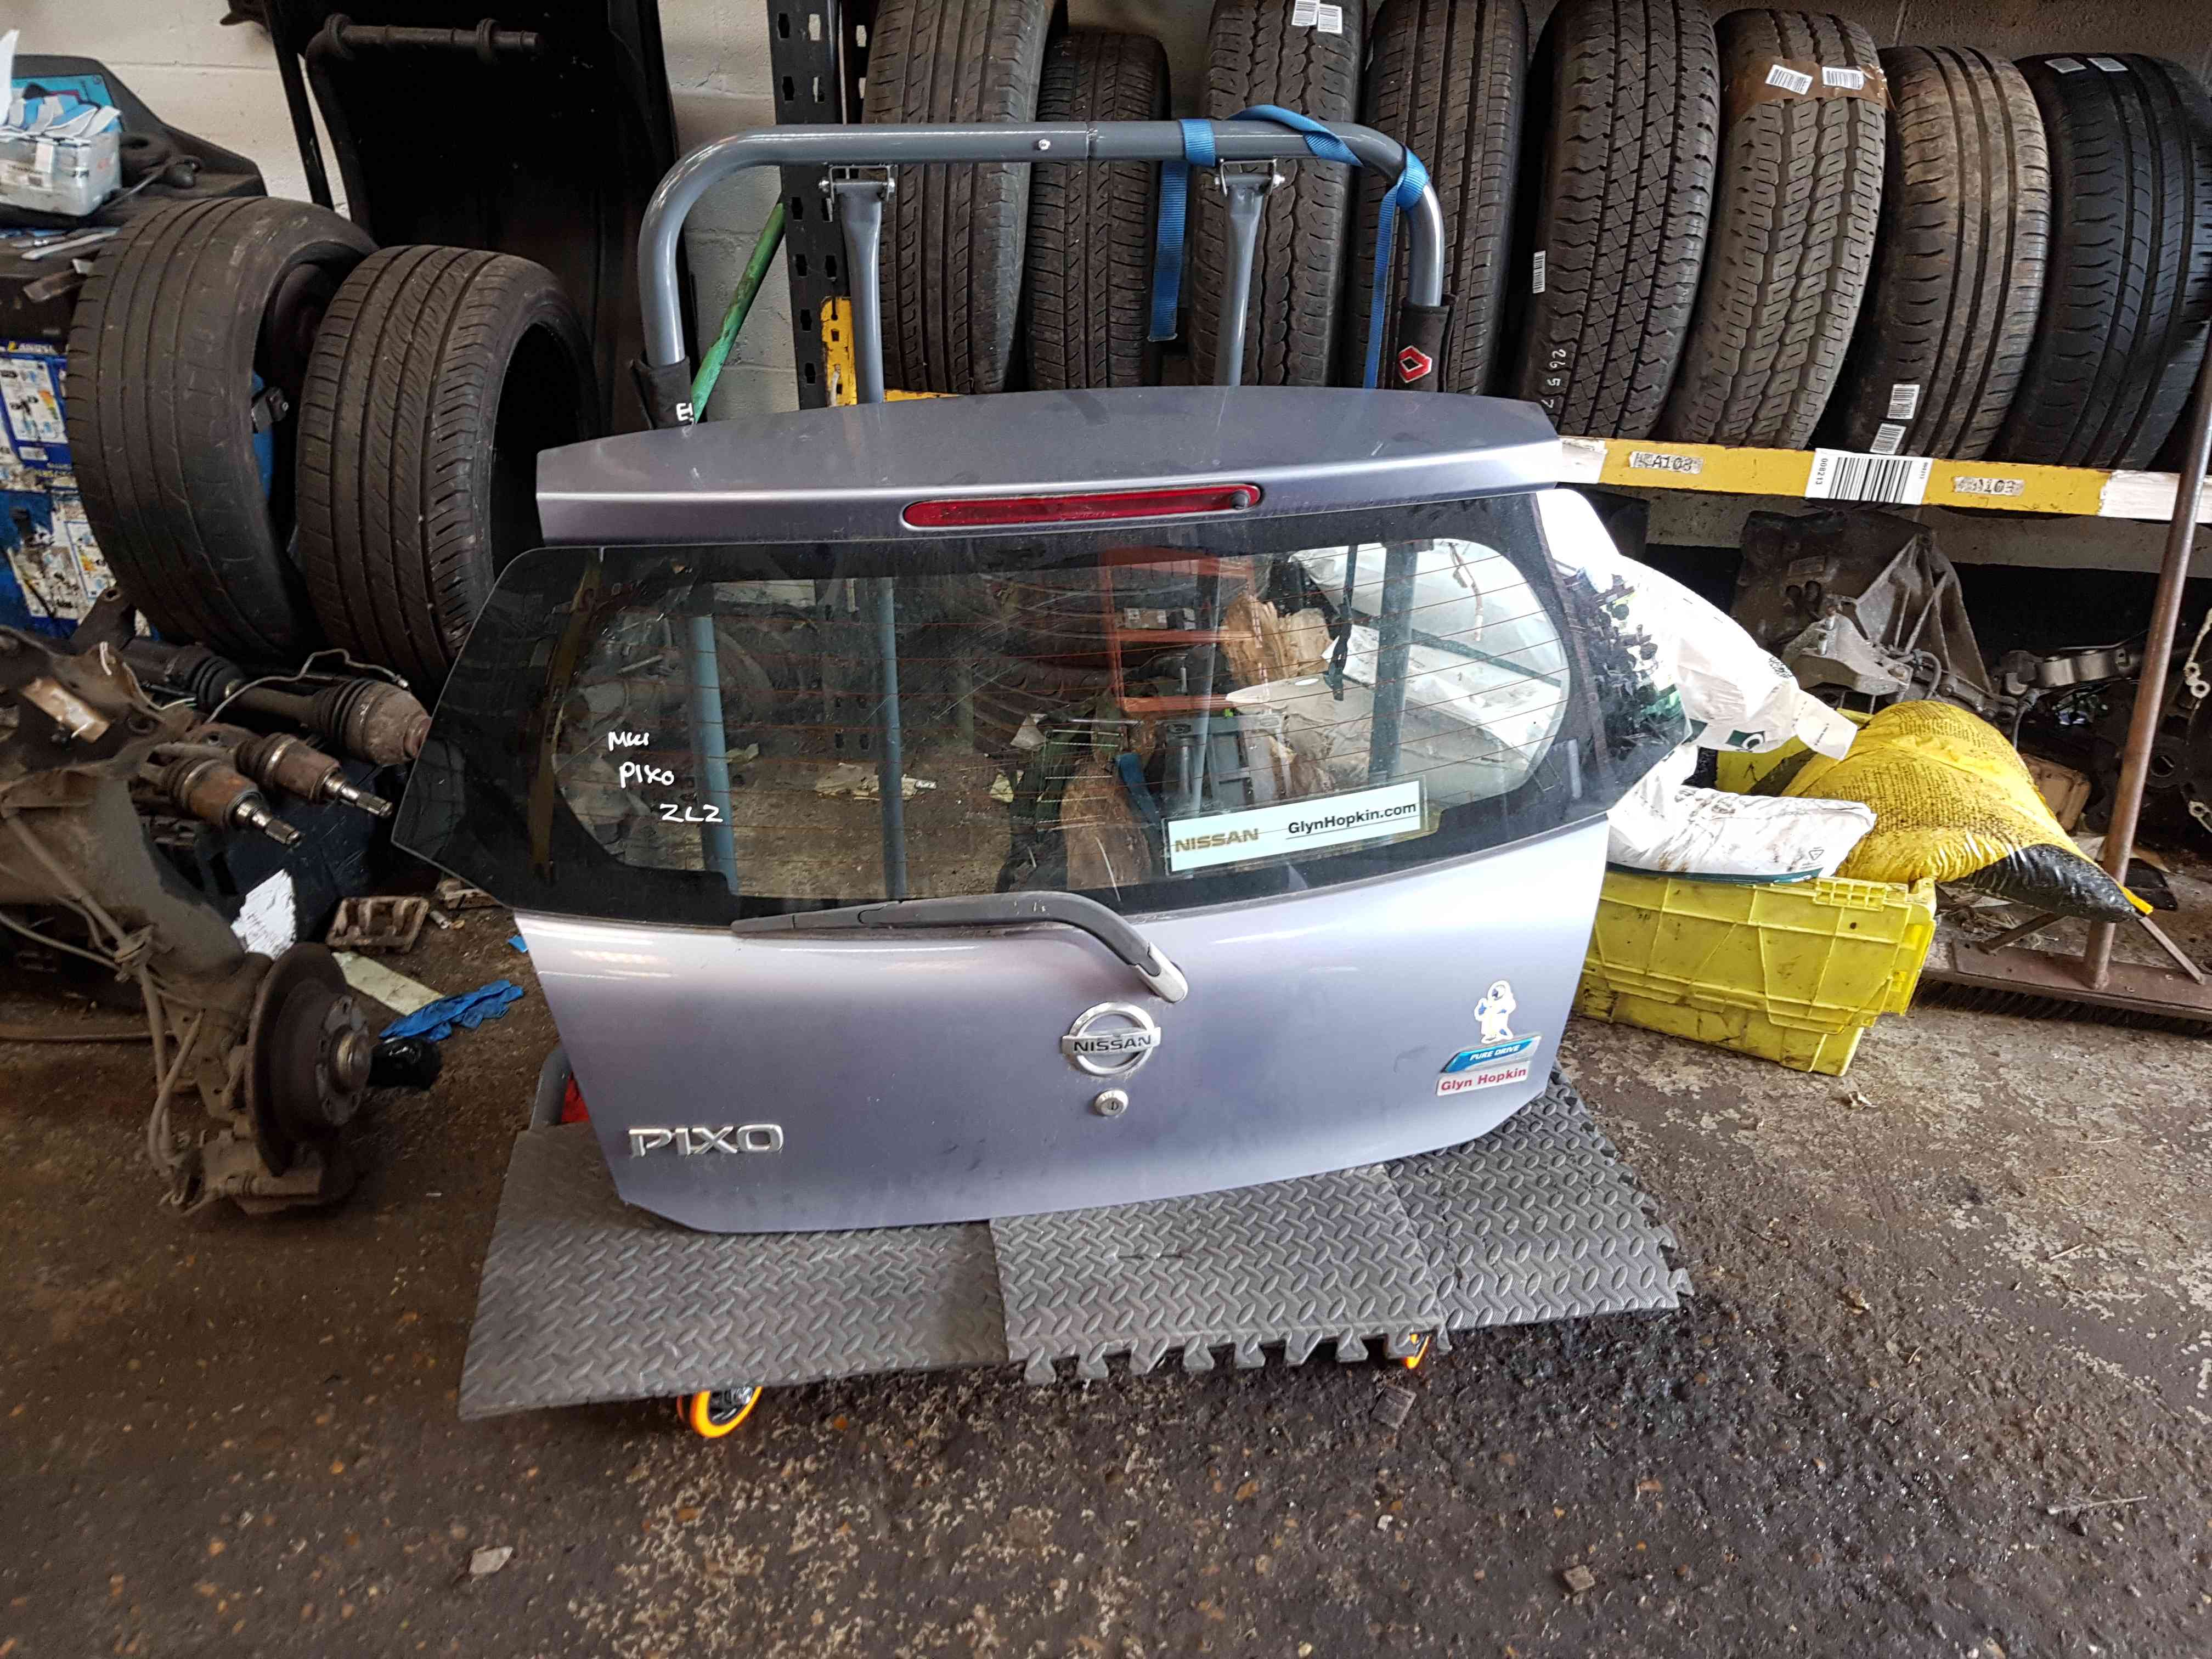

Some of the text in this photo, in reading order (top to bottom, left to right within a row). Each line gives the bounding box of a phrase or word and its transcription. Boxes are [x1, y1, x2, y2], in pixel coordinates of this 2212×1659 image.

[1815, 458, 1829, 486] 008213
[1175, 803, 1417, 853] NISSAN GlynHopkin.com
[1073, 1035, 1152, 1052] NISSAN
[1469, 1044, 1521, 1061] PURE DRIVE
[1441, 1068, 1526, 1091] Glyn Hopkin
[628, 1124, 784, 1158] PIXO
